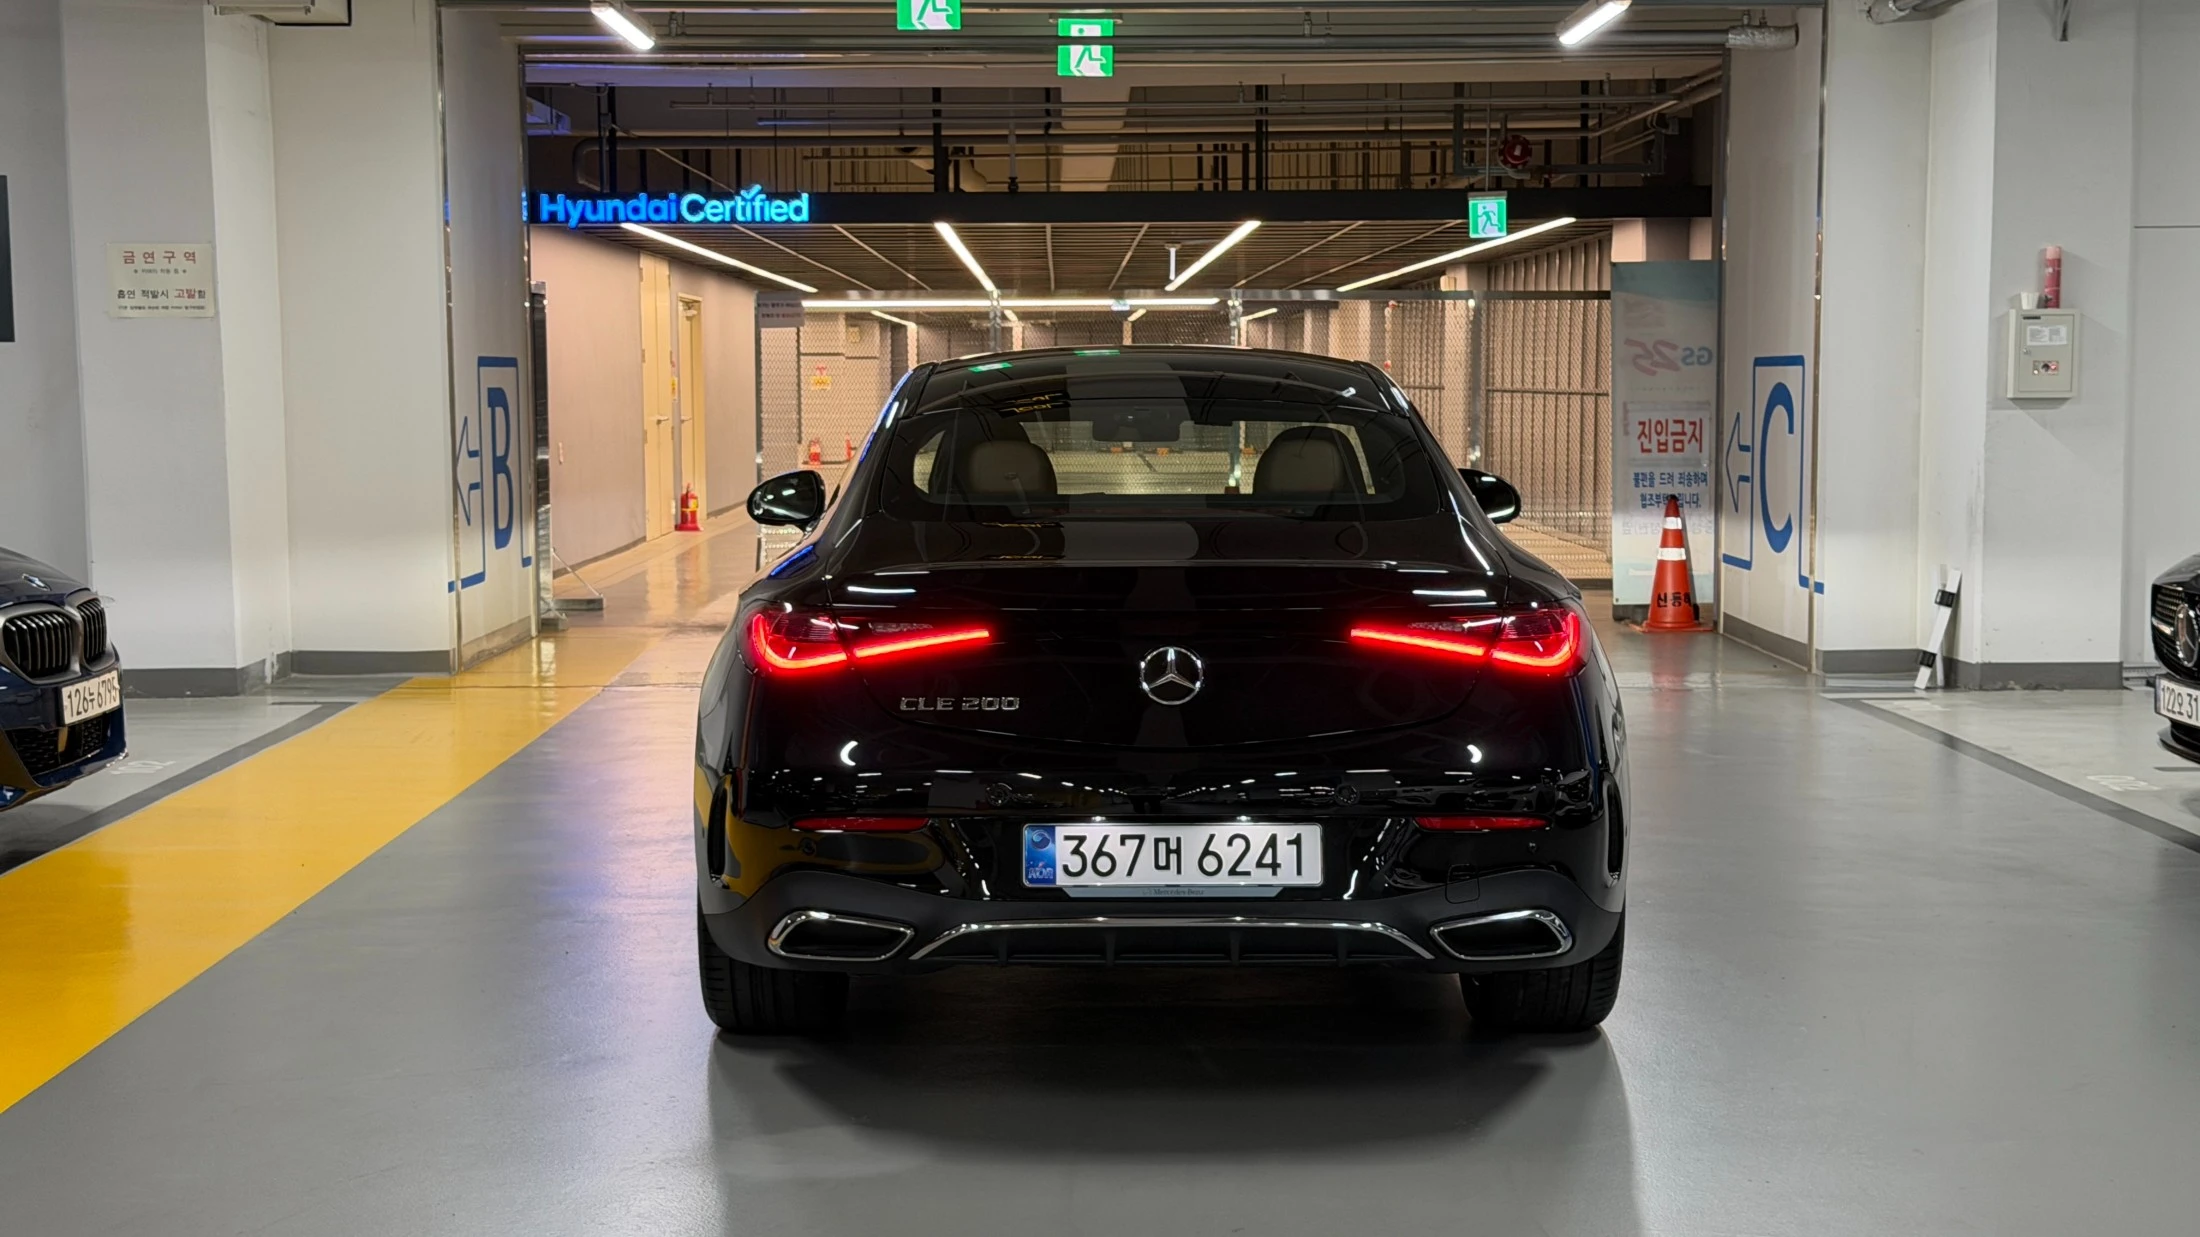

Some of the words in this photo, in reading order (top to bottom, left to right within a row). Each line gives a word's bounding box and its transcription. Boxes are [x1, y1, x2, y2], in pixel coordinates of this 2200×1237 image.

[539, 192, 677, 228] Hyundai
[680, 184, 809, 222] Certified
[117, 289, 136, 299] 흡연
[1637, 418, 1703, 453] 진입금지
[487, 387, 513, 549] B
[1633, 471, 1655, 488] 불편을
[1659, 471, 1674, 488] 드려
[1678, 471, 1708, 488] 죄송하며
[1760, 382, 1794, 553] C
[900, 697, 953, 711] CLE
[962, 697, 1019, 711] 200
[1062, 834, 1182, 877] 367머
[1197, 833, 1303, 877] 6241
